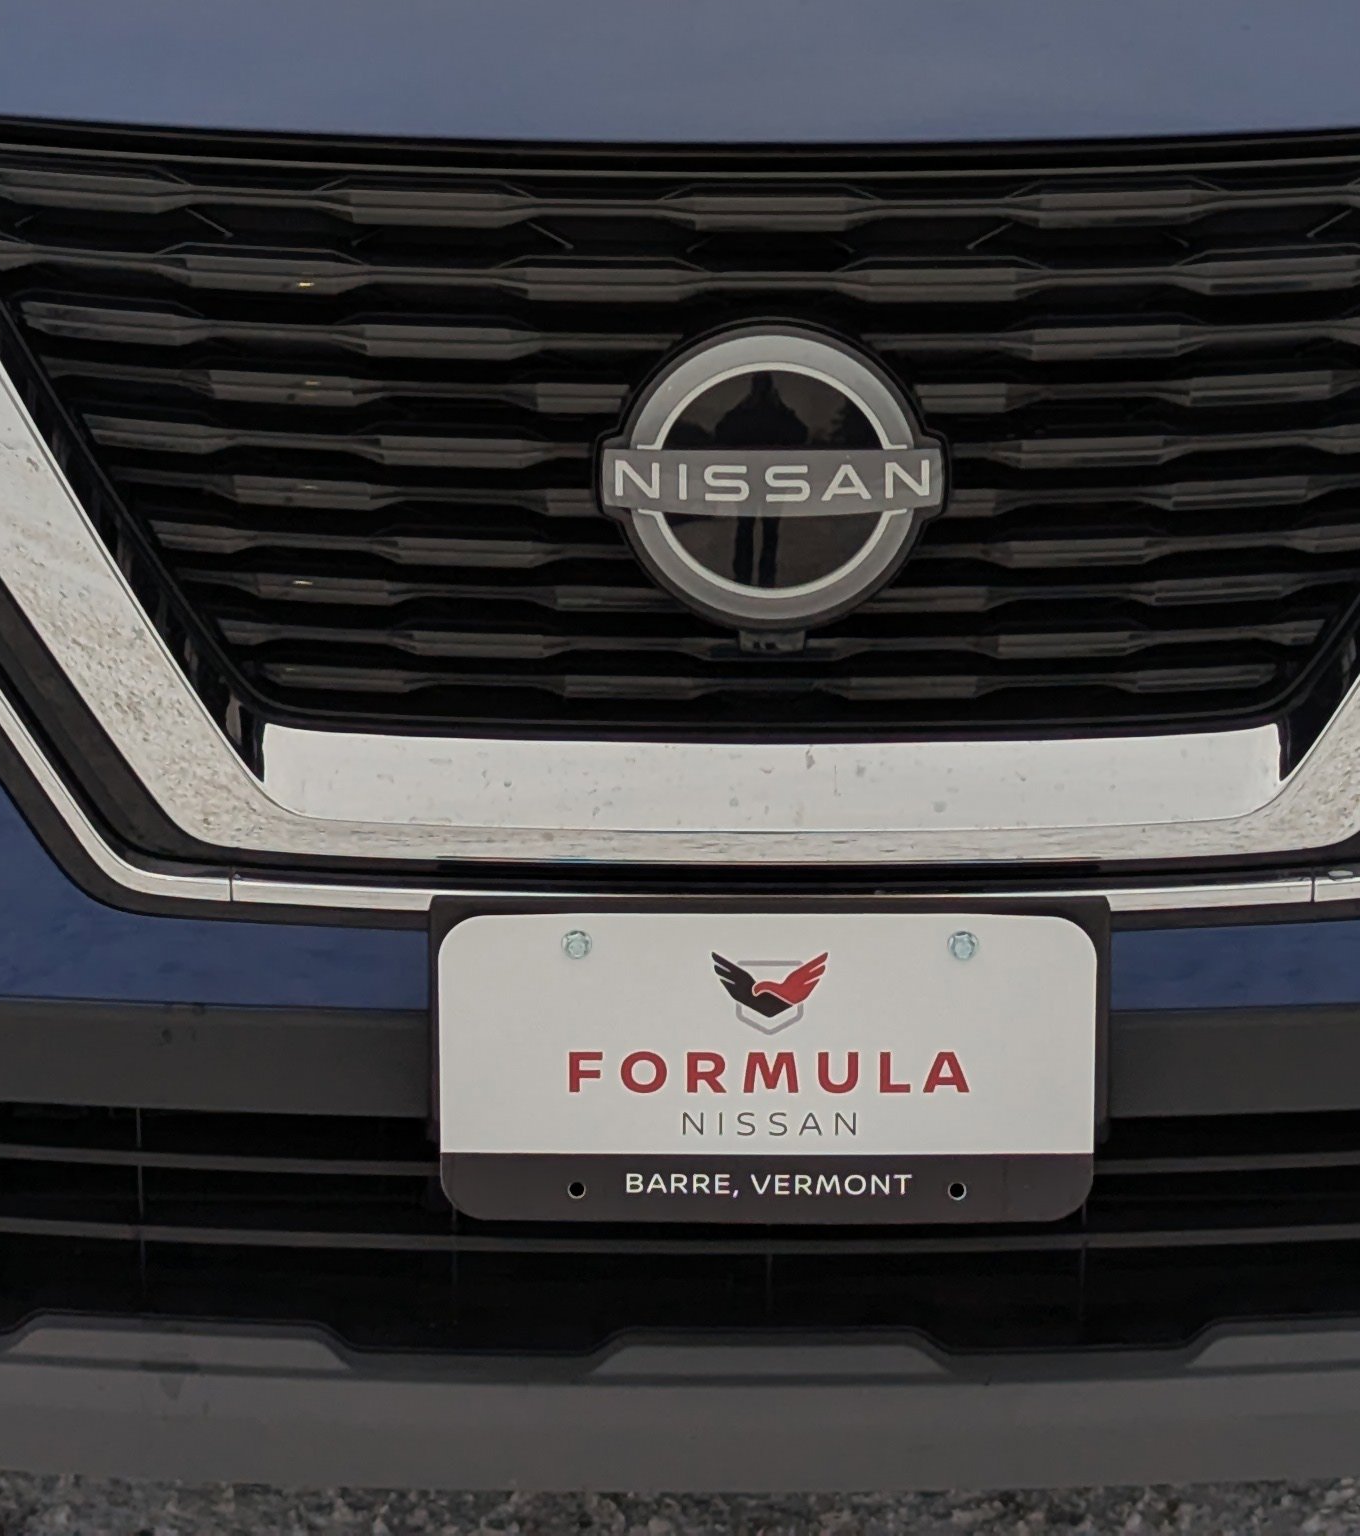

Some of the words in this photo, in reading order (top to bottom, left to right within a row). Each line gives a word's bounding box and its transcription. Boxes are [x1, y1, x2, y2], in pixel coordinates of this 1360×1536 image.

[614, 458, 931, 503] NISSAN
[568, 1051, 970, 1094] FORMULA
[682, 1111, 858, 1137] NISSAN
[625, 1172, 739, 1198] BARRE,
[750, 1173, 913, 1197] VERMONT
